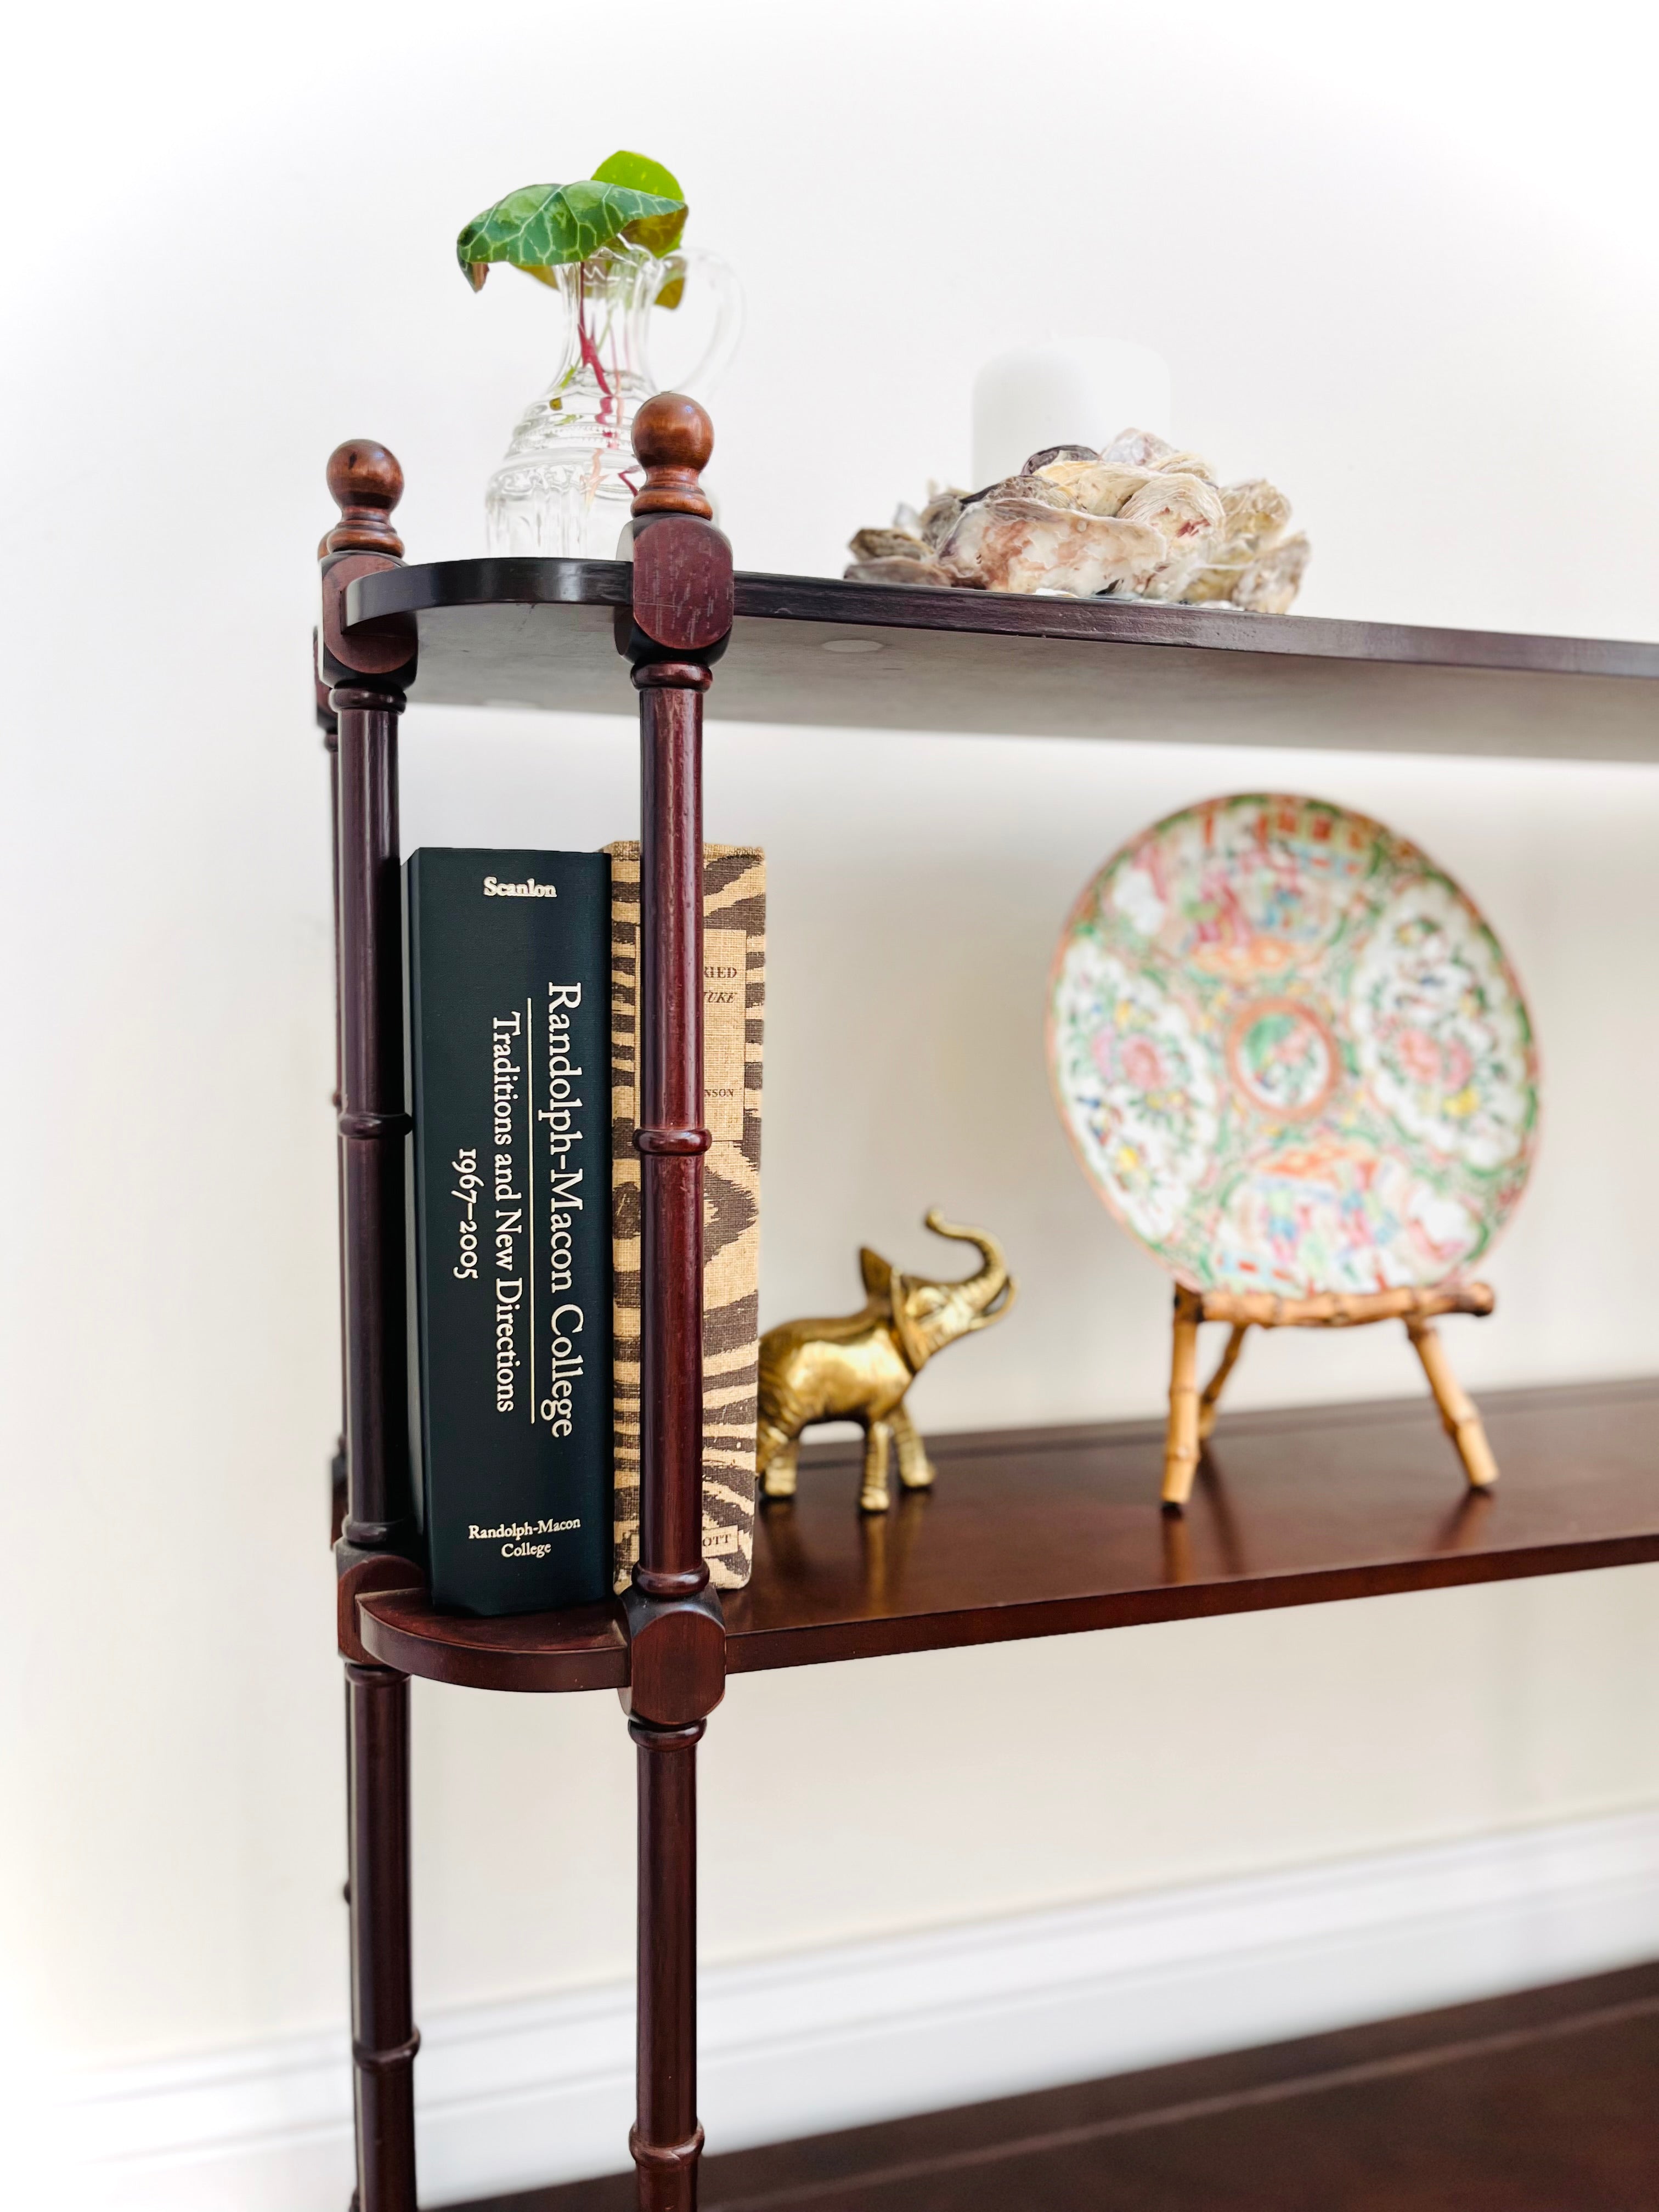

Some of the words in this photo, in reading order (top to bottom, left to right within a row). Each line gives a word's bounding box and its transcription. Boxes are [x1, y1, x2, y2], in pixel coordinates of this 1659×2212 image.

[483, 876, 557, 898] Scanlon
[493, 1011, 521, 1146] Traditions
[538, 981, 583, 1293] Randolph-Macon
[494, 1153, 522, 1201] and
[495, 1209, 522, 1271] New
[496, 1278, 523, 1412] Directions
[540, 1304, 584, 1438] College
[468, 1518, 581, 1541] Randolph-Macon
[501, 1542, 551, 1558] College
